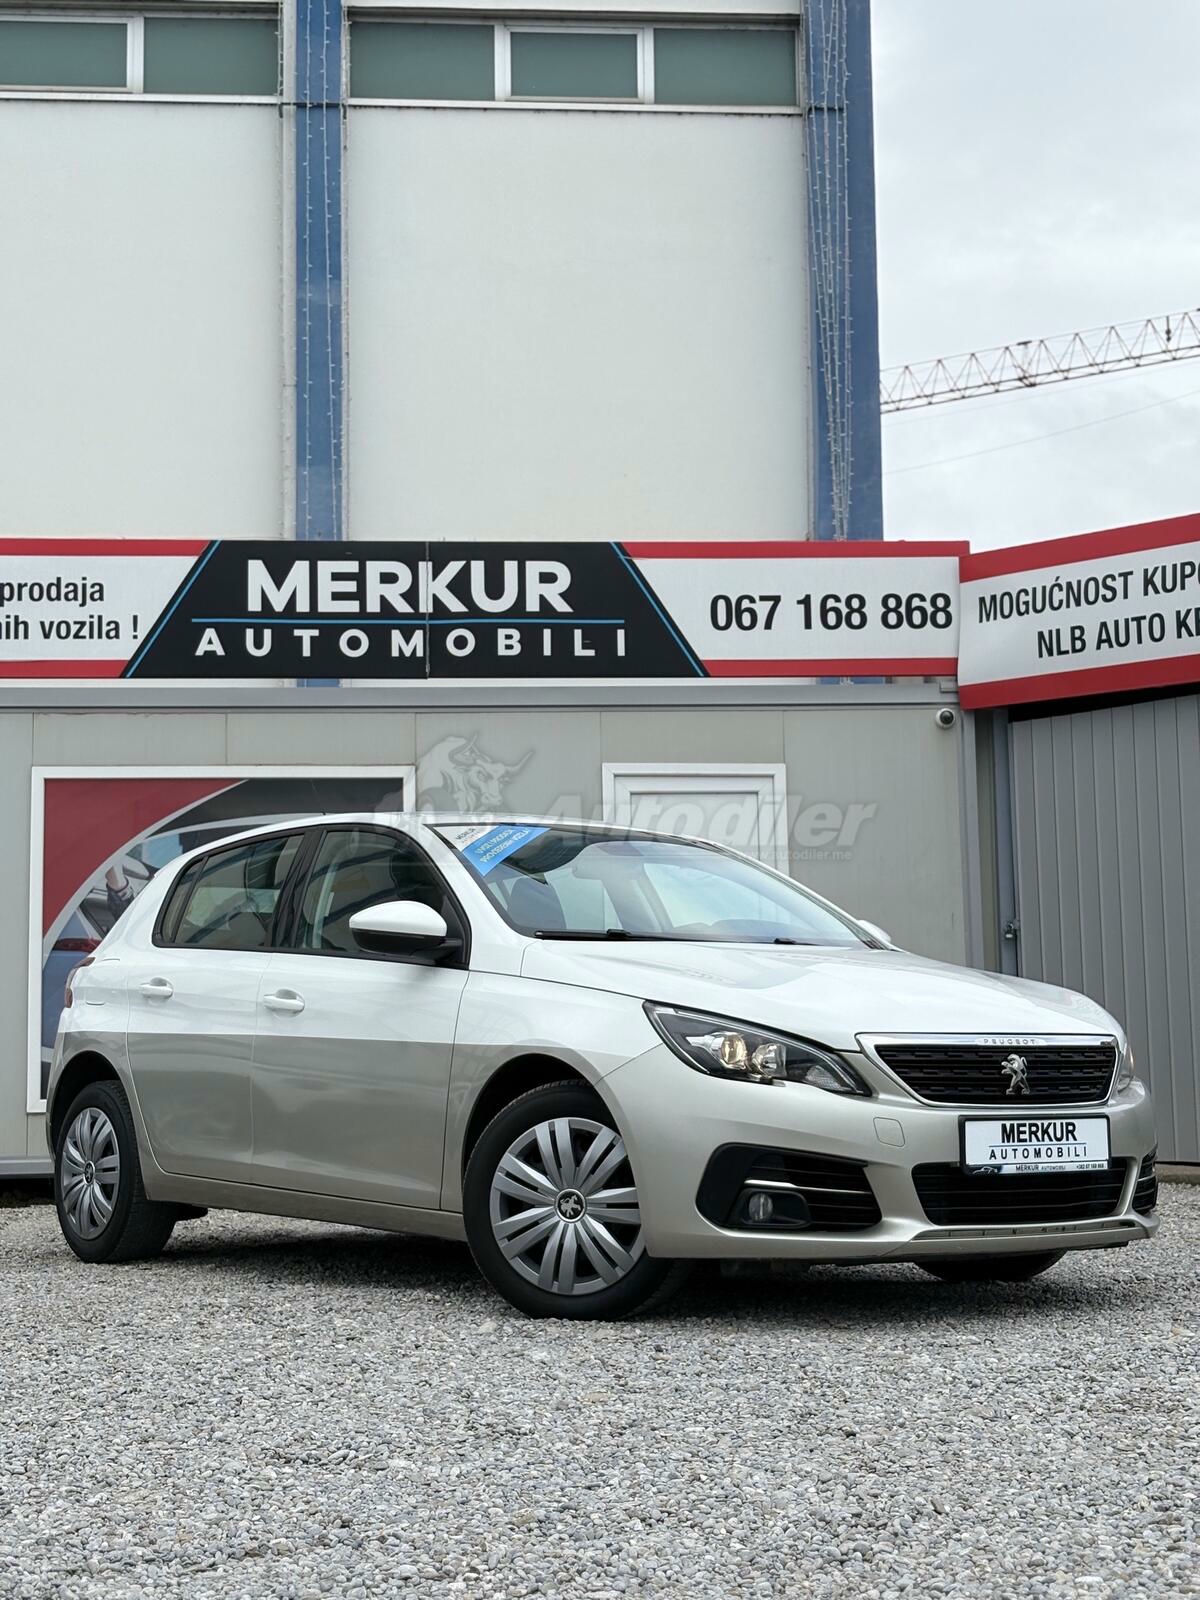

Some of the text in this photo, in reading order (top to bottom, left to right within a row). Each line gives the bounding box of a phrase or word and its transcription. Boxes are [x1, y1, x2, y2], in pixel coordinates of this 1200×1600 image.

[0, 576, 105, 608] prodaja
[247, 559, 573, 613] MERKUR
[978, 560, 1200, 624] MOGUĆNOST KUP
[0, 614, 30, 640] ih
[39, 614, 121, 640] vozila
[709, 592, 952, 631] 067 168 868
[195, 628, 626, 658] AUTOMOBILI
[1037, 629, 1087, 659] NLB
[1095, 612, 1166, 651] AUTO
[983, 1037, 1036, 1046] PEUGEOT
[1001, 1121, 1077, 1144] MERKUR
[989, 1146, 1087, 1160] AUTOMOBILI
